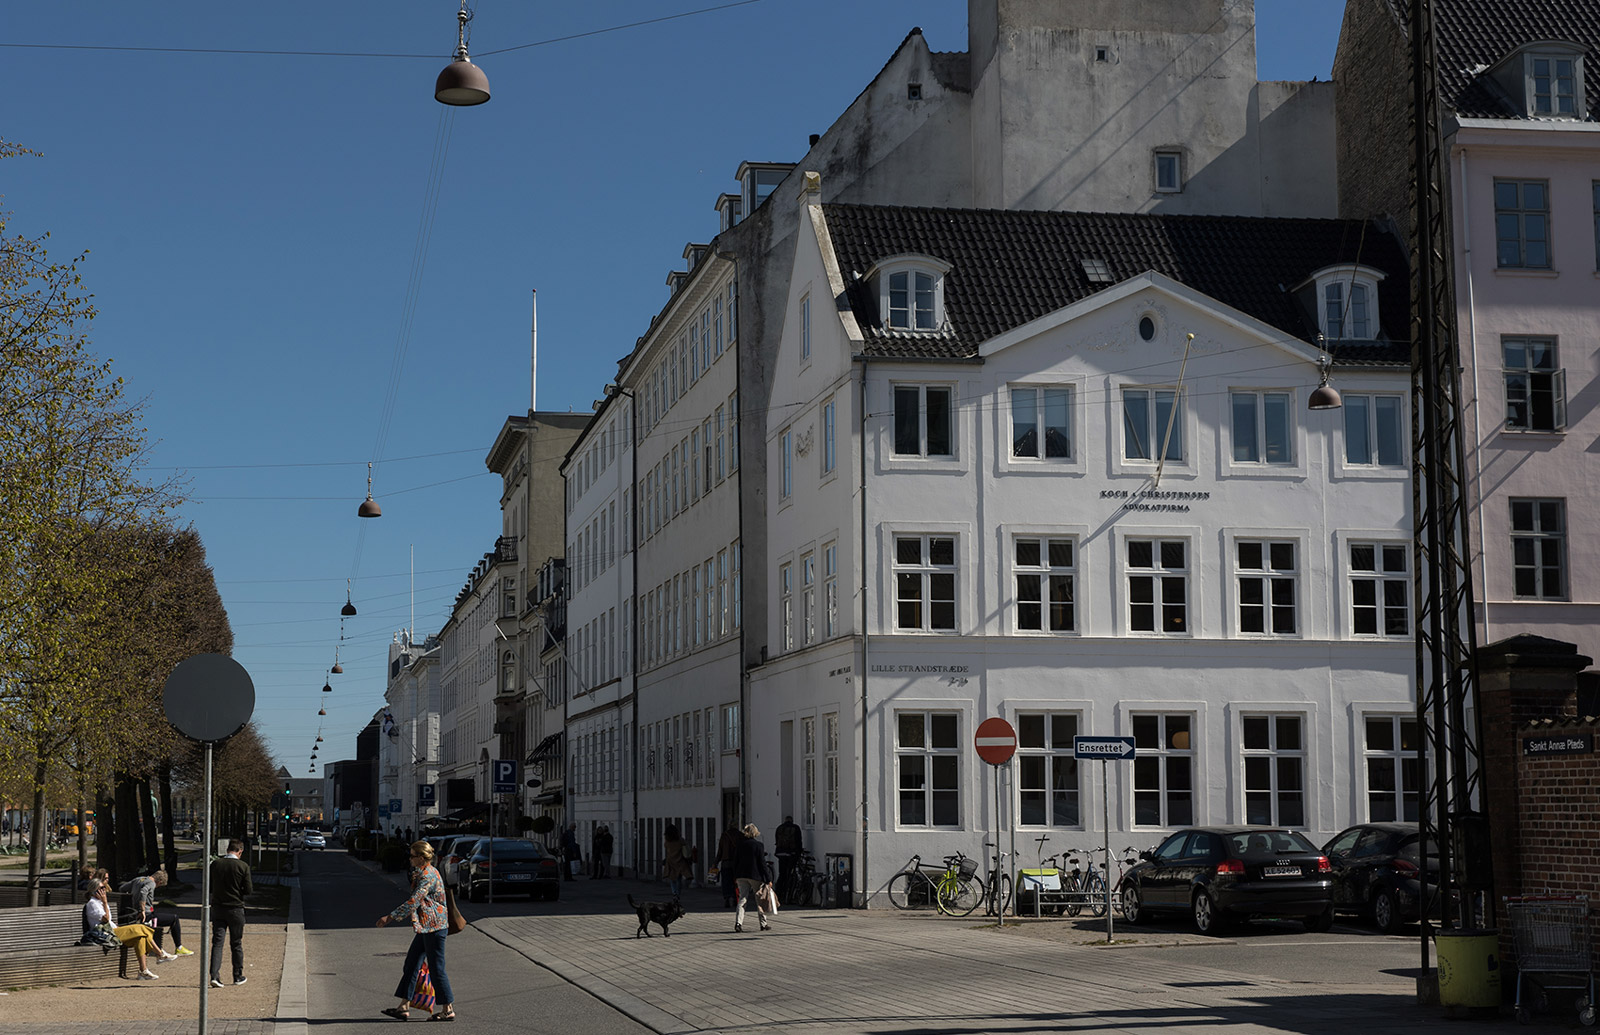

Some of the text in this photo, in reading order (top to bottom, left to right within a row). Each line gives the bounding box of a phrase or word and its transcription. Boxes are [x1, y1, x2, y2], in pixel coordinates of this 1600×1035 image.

[1100, 490, 1128, 498] KOCH
[1141, 490, 1210, 499] CHRISTENSEN
[1122, 504, 1190, 512] ADVOKATFIRMA
[898, 665, 969, 673] STRANDSTRÆDE
[1079, 743, 1122, 752] Ensrettet
[1529, 739, 1585, 751] Sankt Annæ Plads
[500, 763, 512, 781] P
[423, 786, 432, 798] P
